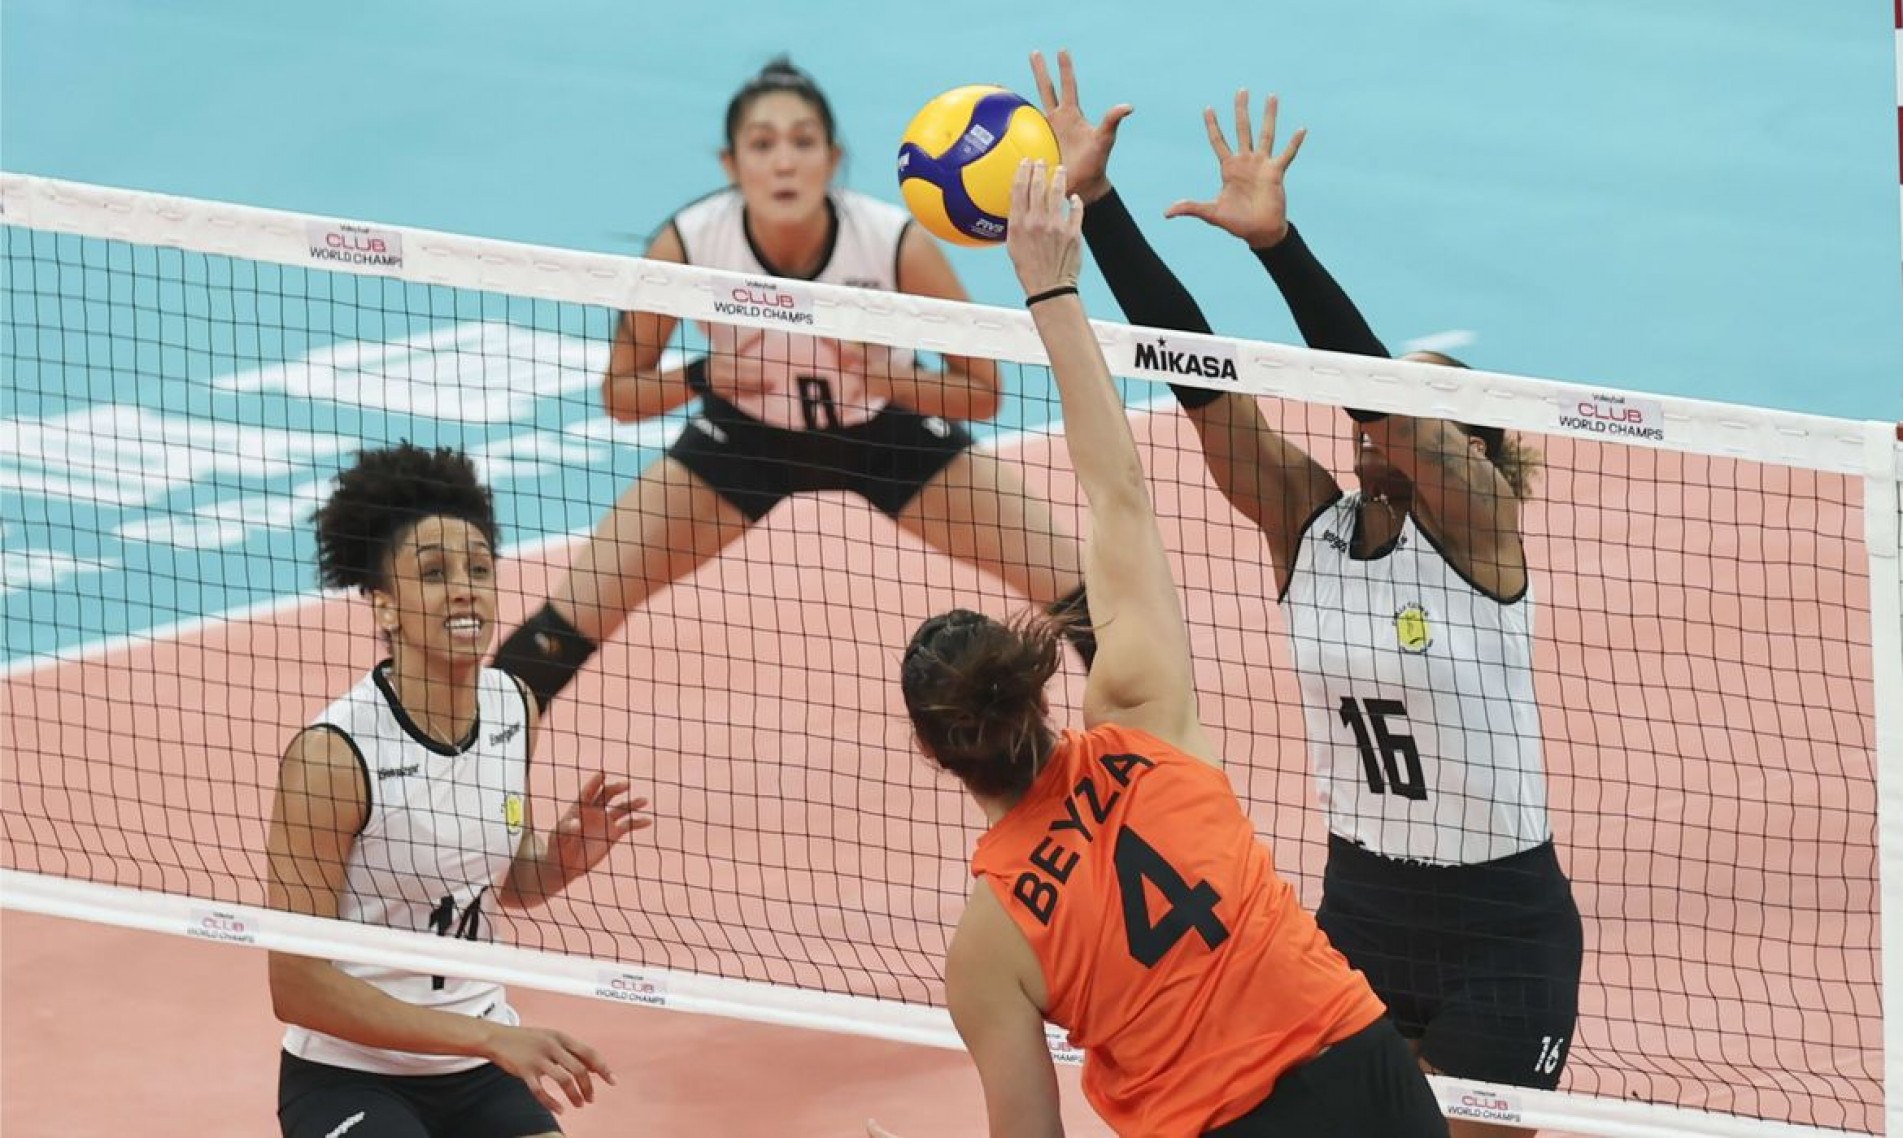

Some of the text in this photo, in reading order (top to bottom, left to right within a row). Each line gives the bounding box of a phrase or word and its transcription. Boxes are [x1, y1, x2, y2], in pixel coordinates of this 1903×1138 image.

[310, 246, 351, 262] WORLD
[326, 233, 386, 252] CLUB
[732, 288, 794, 309] CLUB
[714, 301, 814, 325] WORLD CHAMPS
[1135, 336, 1238, 380] MIKASA
[1578, 402, 1643, 423] CLUB
[1559, 415, 1664, 440] WORLD CHAMPS
[1338, 696, 1428, 801] 16
[1013, 752, 1155, 926] BEYZA
[1114, 823, 1231, 969] 4
[1534, 1036, 1564, 1074] 16
[1461, 1095, 1509, 1110] CLUB
